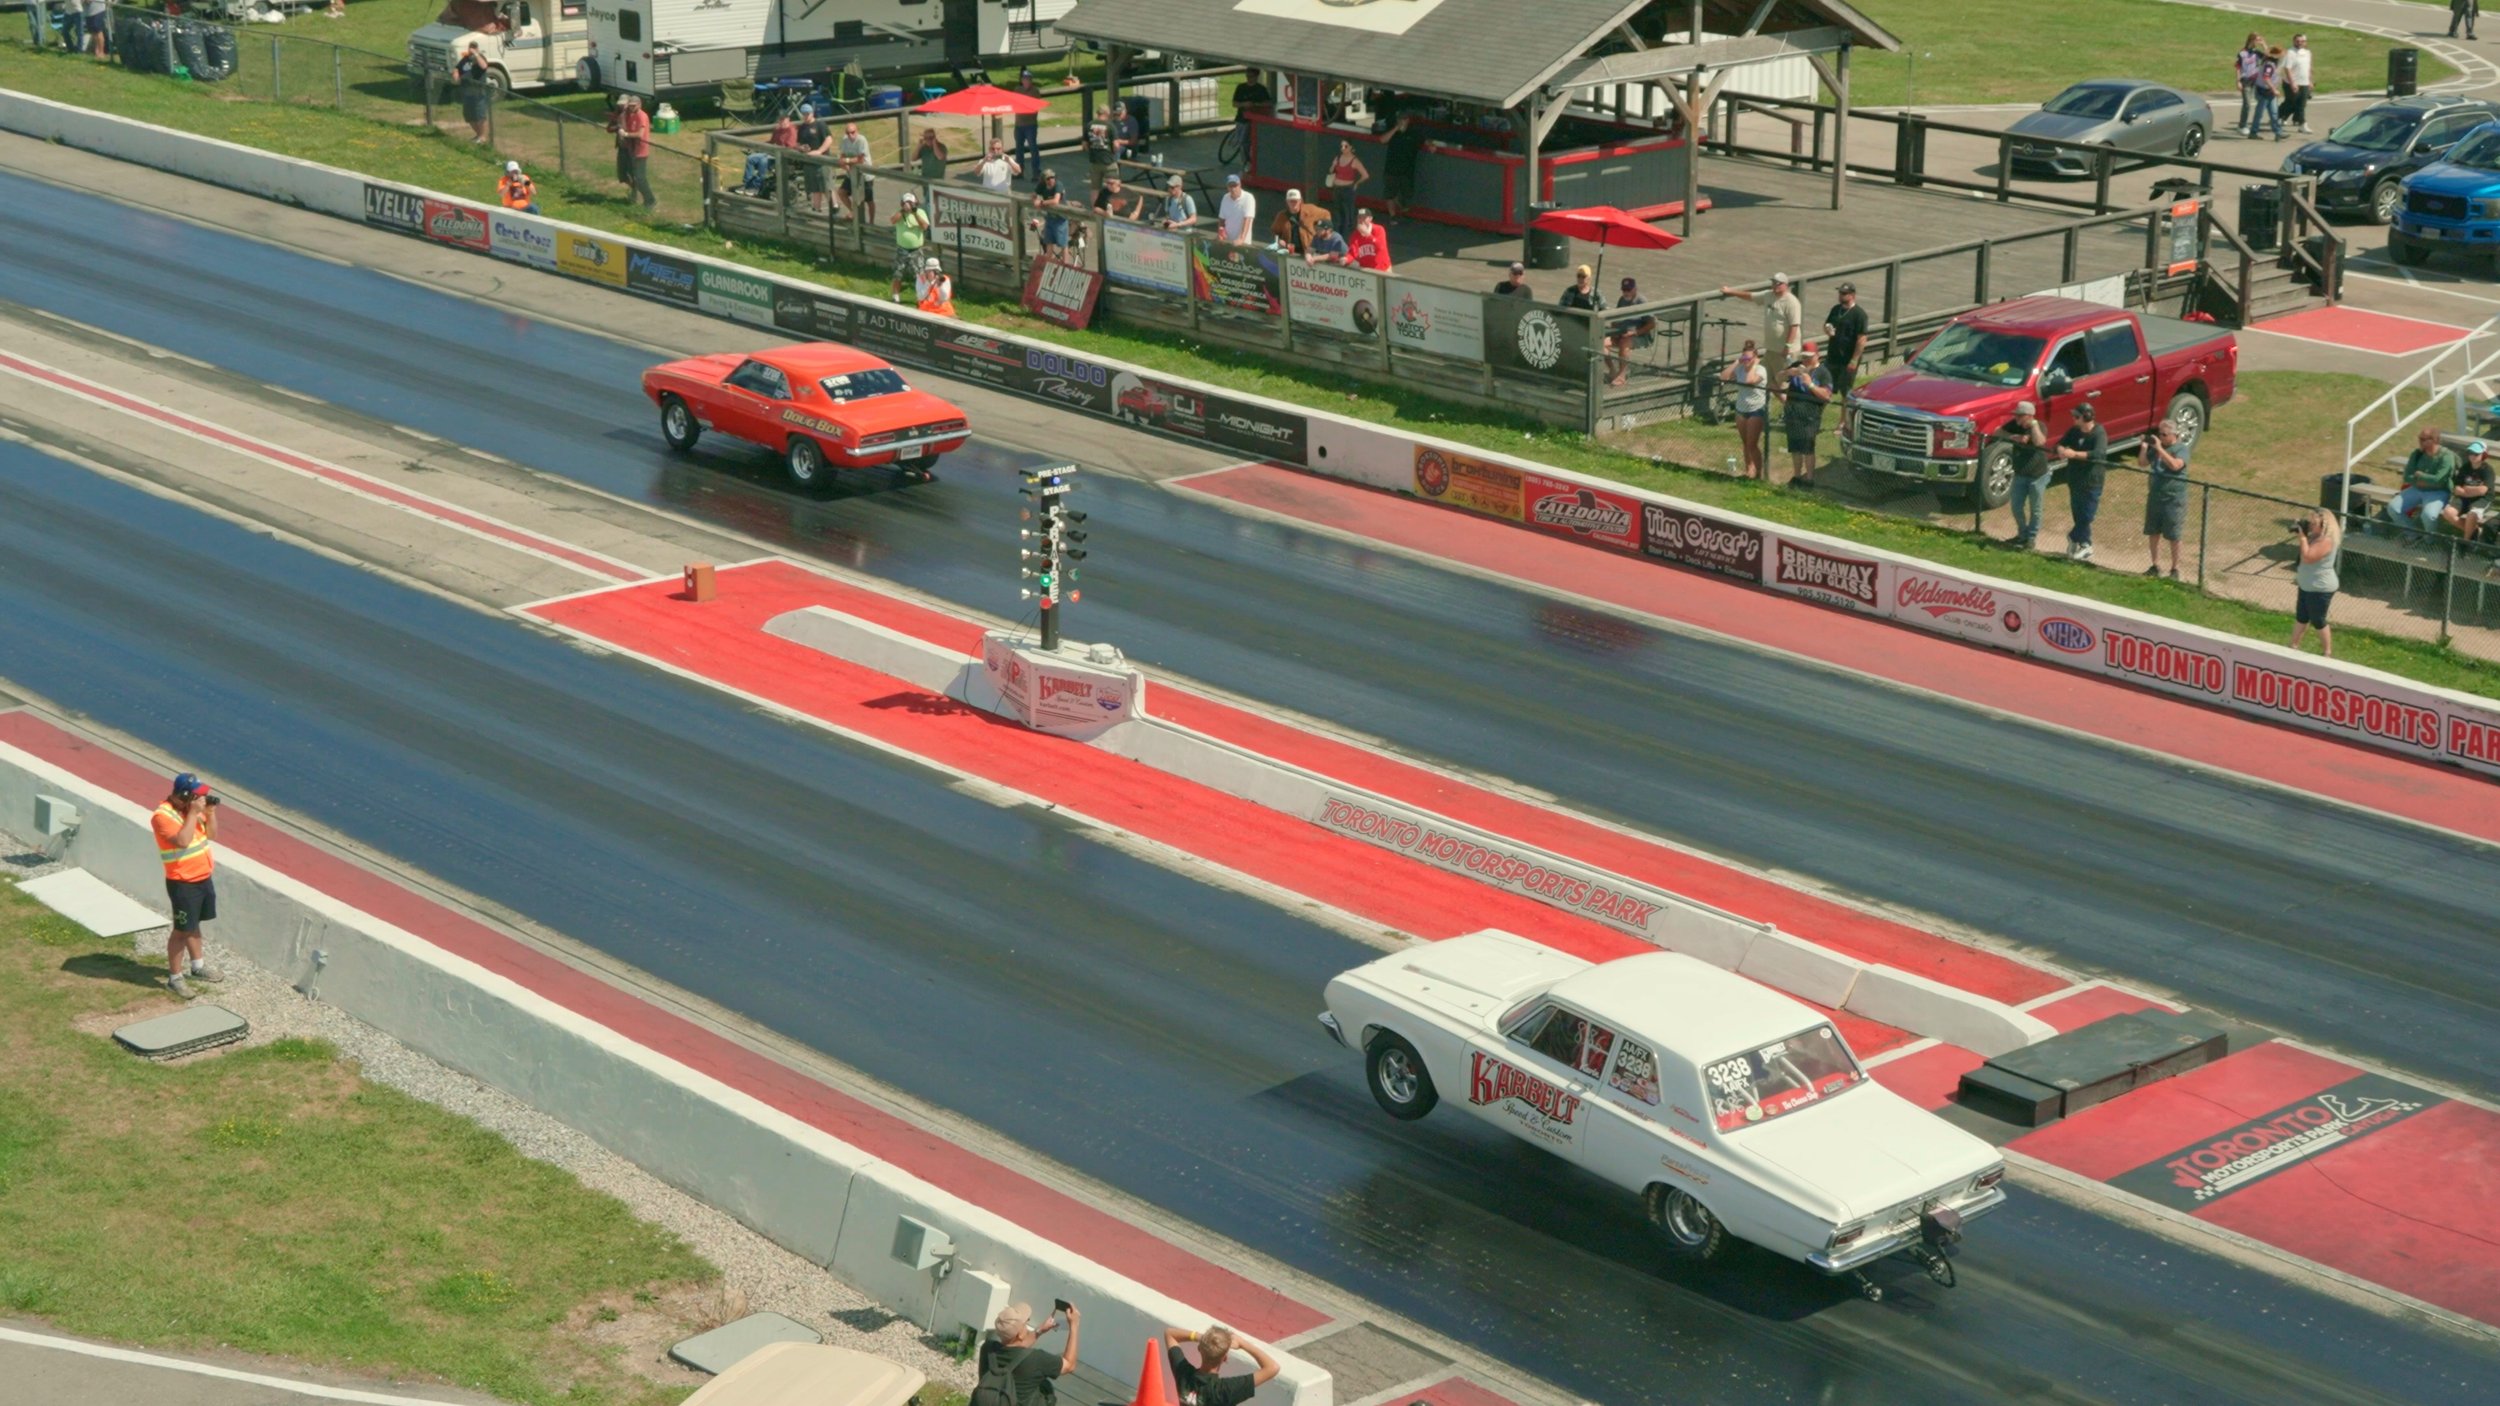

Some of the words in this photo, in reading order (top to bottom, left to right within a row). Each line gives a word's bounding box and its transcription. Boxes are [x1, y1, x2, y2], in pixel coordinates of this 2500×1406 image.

[589, 8, 616, 22] Jayco
[366, 187, 425, 225] LYELL'S
[938, 196, 1007, 226] BREAKAWAY
[939, 212, 972, 225] AUTO
[976, 217, 1010, 235] GLASS
[943, 231, 1005, 250] 90.577.5120
[702, 271, 768, 302] GLANBROOK
[1290, 264, 1317, 279] DON'T
[1319, 271, 1336, 284] PUT
[1339, 275, 1346, 286] IT
[1291, 279, 1308, 290] CALL
[1310, 284, 1348, 298] SOKOLOFF
[870, 315, 886, 328] AD
[889, 319, 929, 339] TUNING
[1396, 321, 1425, 332] MATCO
[1397, 327, 1425, 340] TOOLS
[1026, 349, 1106, 388] DOLDO
[1033, 377, 1095, 406] Racing
[782, 408, 815, 428] DOUG
[816, 420, 843, 437] BOX
[1220, 412, 1294, 439] MIDNIGHT
[1037, 464, 1077, 478] PRE-STAGE
[1043, 484, 1071, 496] STAGE
[1534, 500, 1631, 527] CALEDONIA
[1645, 507, 1684, 548] Tim
[1684, 517, 1759, 560] Orser's
[1782, 546, 1874, 585] BREAKAWAY
[1782, 564, 1822, 583] AUTO
[1827, 574, 1874, 600] GLASS
[1898, 576, 1996, 615] Oldsmobile
[1797, 586, 1855, 610] 905.577.5120
[1943, 614, 1961, 626] CLUB
[2044, 621, 2090, 649] NHRA
[1039, 675, 1093, 700] KARBELT
[2103, 628, 2225, 694] TORONTO
[2233, 661, 2440, 749] MOTORSPORTS
[2447, 715, 2500, 767] PAR
[1320, 798, 1421, 848] TORONTO
[1415, 830, 1588, 905] MOTORSPORTS
[1583, 887, 1663, 930] PARK
[1617, 1051, 1651, 1079] 3238
[1623, 1041, 1649, 1062] AA/FX
[1708, 1057, 1751, 1086] 3238
[1468, 1050, 1581, 1126] KARBELT
[1722, 1077, 1749, 1095] AA/FX
[1503, 1100, 1529, 1121] Speed
[1541, 1117, 1573, 1141] Custom
[2340, 1110, 2400, 1137] CAYUGA
[2167, 1106, 2333, 1177] TORONTO
[2201, 1135, 2311, 1183] MOTORSPORTS
[2304, 1118, 2349, 1141] PARK
